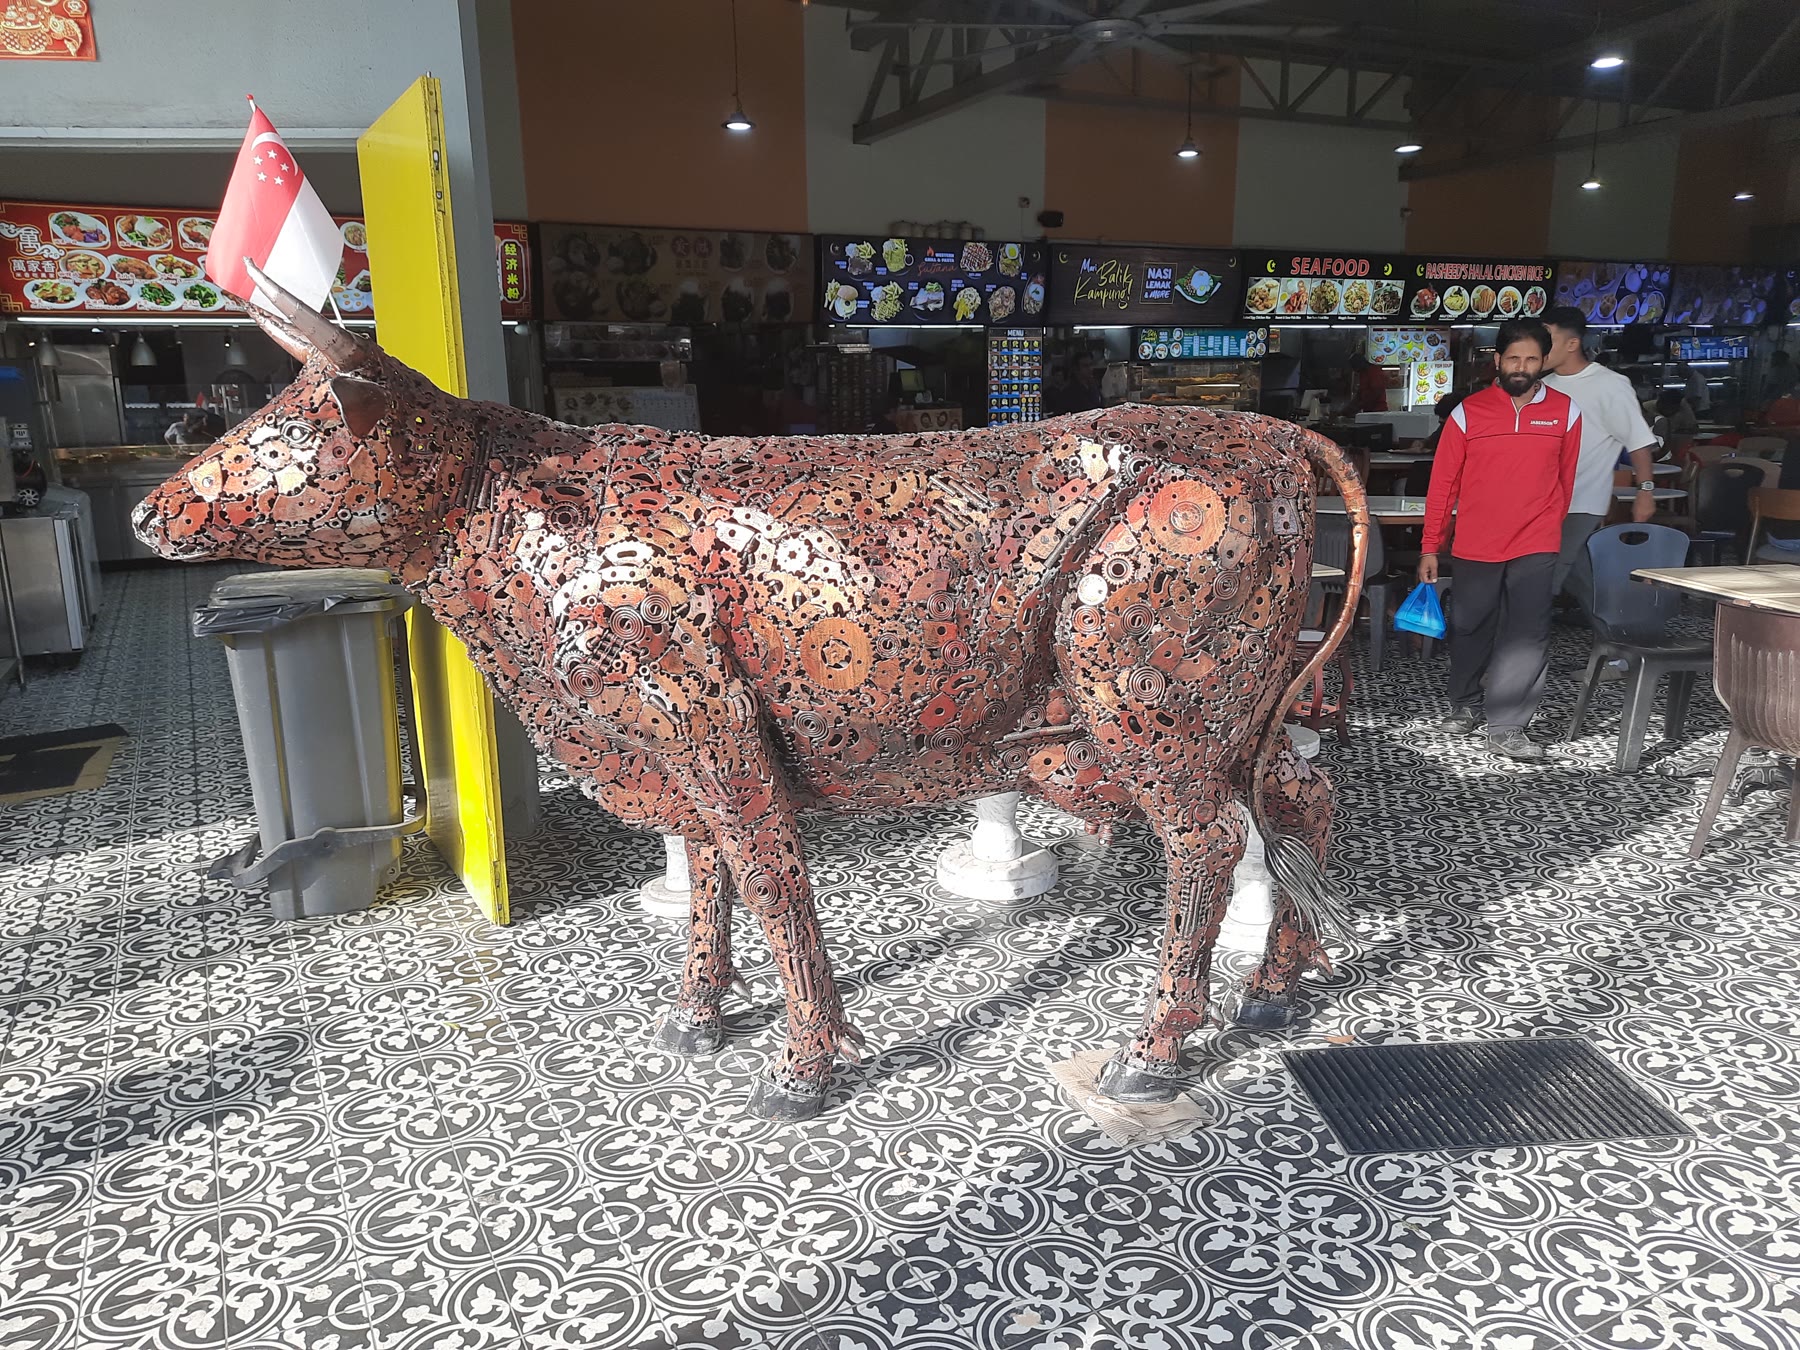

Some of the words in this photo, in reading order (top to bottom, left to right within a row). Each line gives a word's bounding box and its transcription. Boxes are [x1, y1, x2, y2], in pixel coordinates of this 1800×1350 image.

[12, 259, 56, 273] 萬家香
[505, 243, 519, 299] 经济米粉
[1081, 258, 1098, 274] Mari
[1096, 260, 1133, 287] Balik
[1290, 257, 1370, 276] SEAFOOD
[1425, 263, 1469, 280] RASHEED'S
[1468, 264, 1494, 281] HALAL
[1494, 265, 1527, 281] CHICKEN
[1526, 265, 1544, 282] RICE
[1147, 267, 1172, 280] NASI
[1145, 280, 1171, 289] LEMAK
[1149, 290, 1170, 299] MORE
[1007, 329, 1024, 337] MENU
